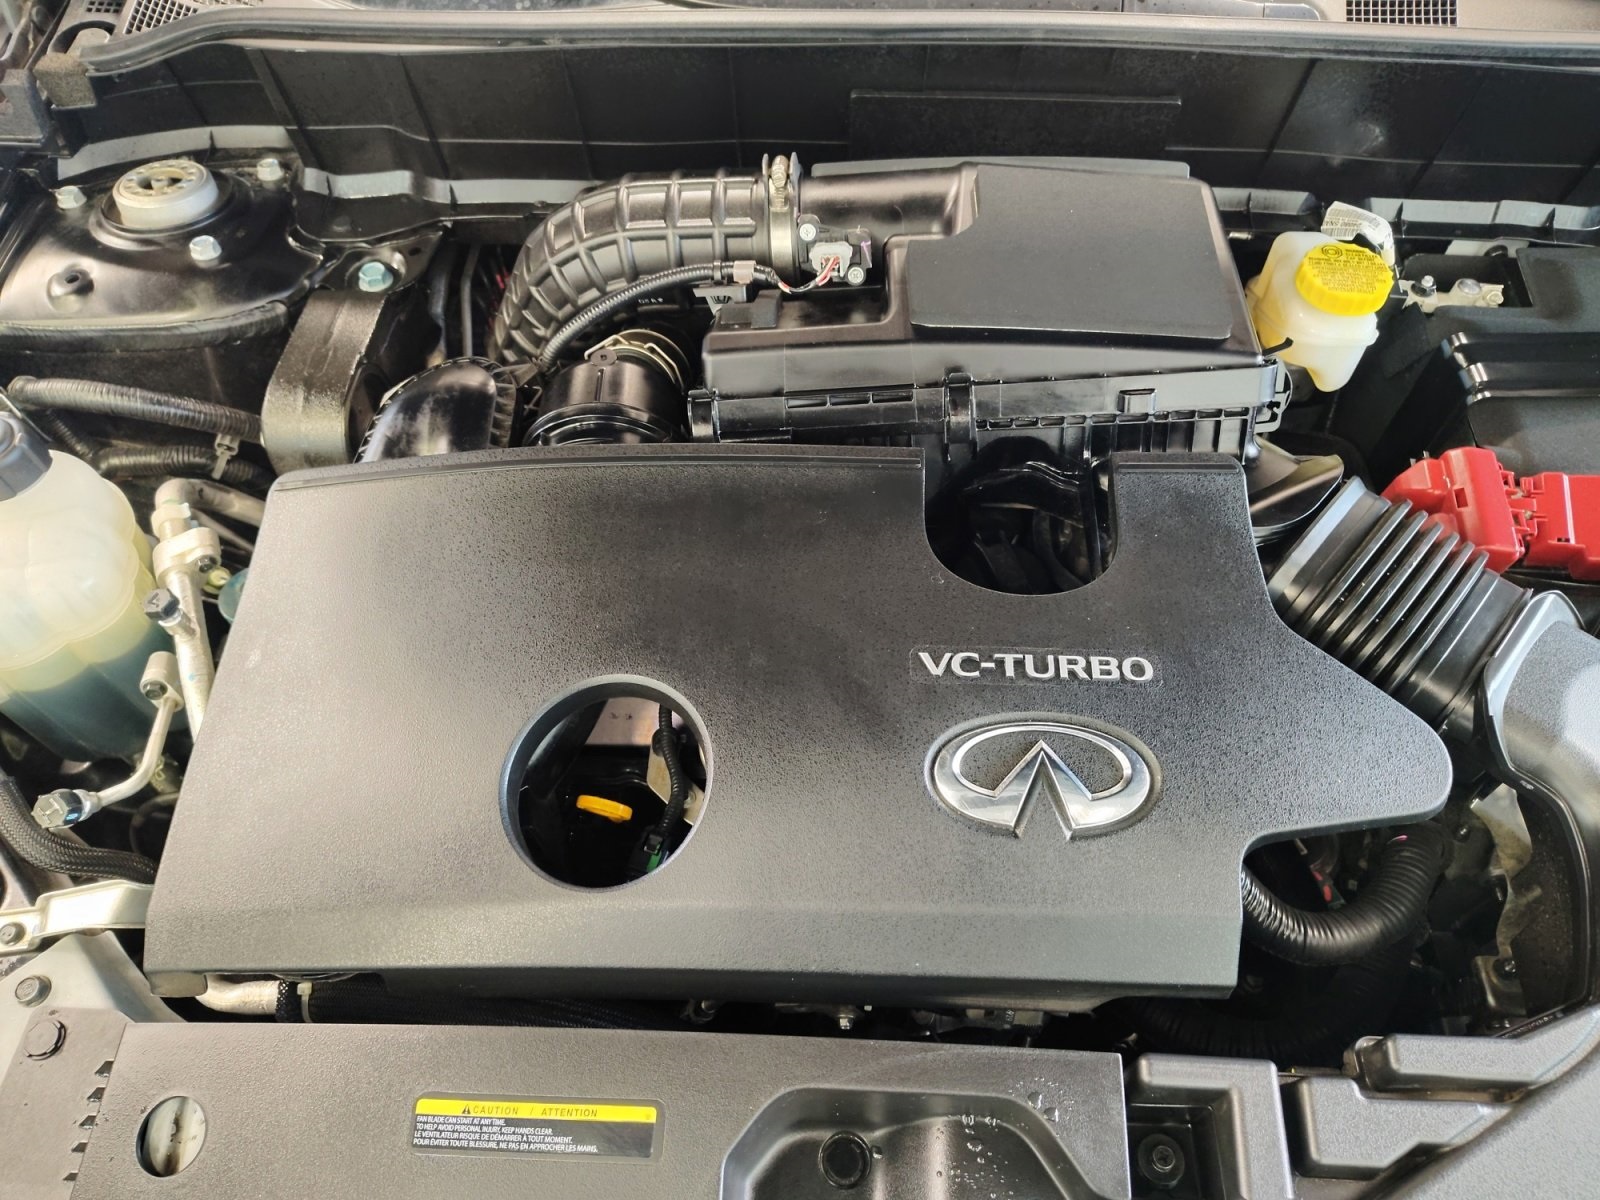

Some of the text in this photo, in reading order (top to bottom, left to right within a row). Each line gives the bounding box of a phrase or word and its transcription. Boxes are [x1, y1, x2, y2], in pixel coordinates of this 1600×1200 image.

[918, 652, 1154, 681] VC-TURBO
[473, 1105, 519, 1115] CAUTION
[541, 1107, 598, 1117] ATTENTION
[421, 1131, 459, 1139] VENTILATEUR
[459, 1132, 480, 1140] RISQUE
[490, 1132, 522, 1142] DÉMARRER
[544, 1136, 573, 1144] MOMENT.
[450, 1139, 468, 1147] TOUTE
[499, 1141, 508, 1149] NE
[520, 1142, 529, 1150] EN
[529, 1143, 565, 1151] APPROCHER
[565, 1144, 577, 1152] LES
[577, 1144, 598, 1153] MAINS.
